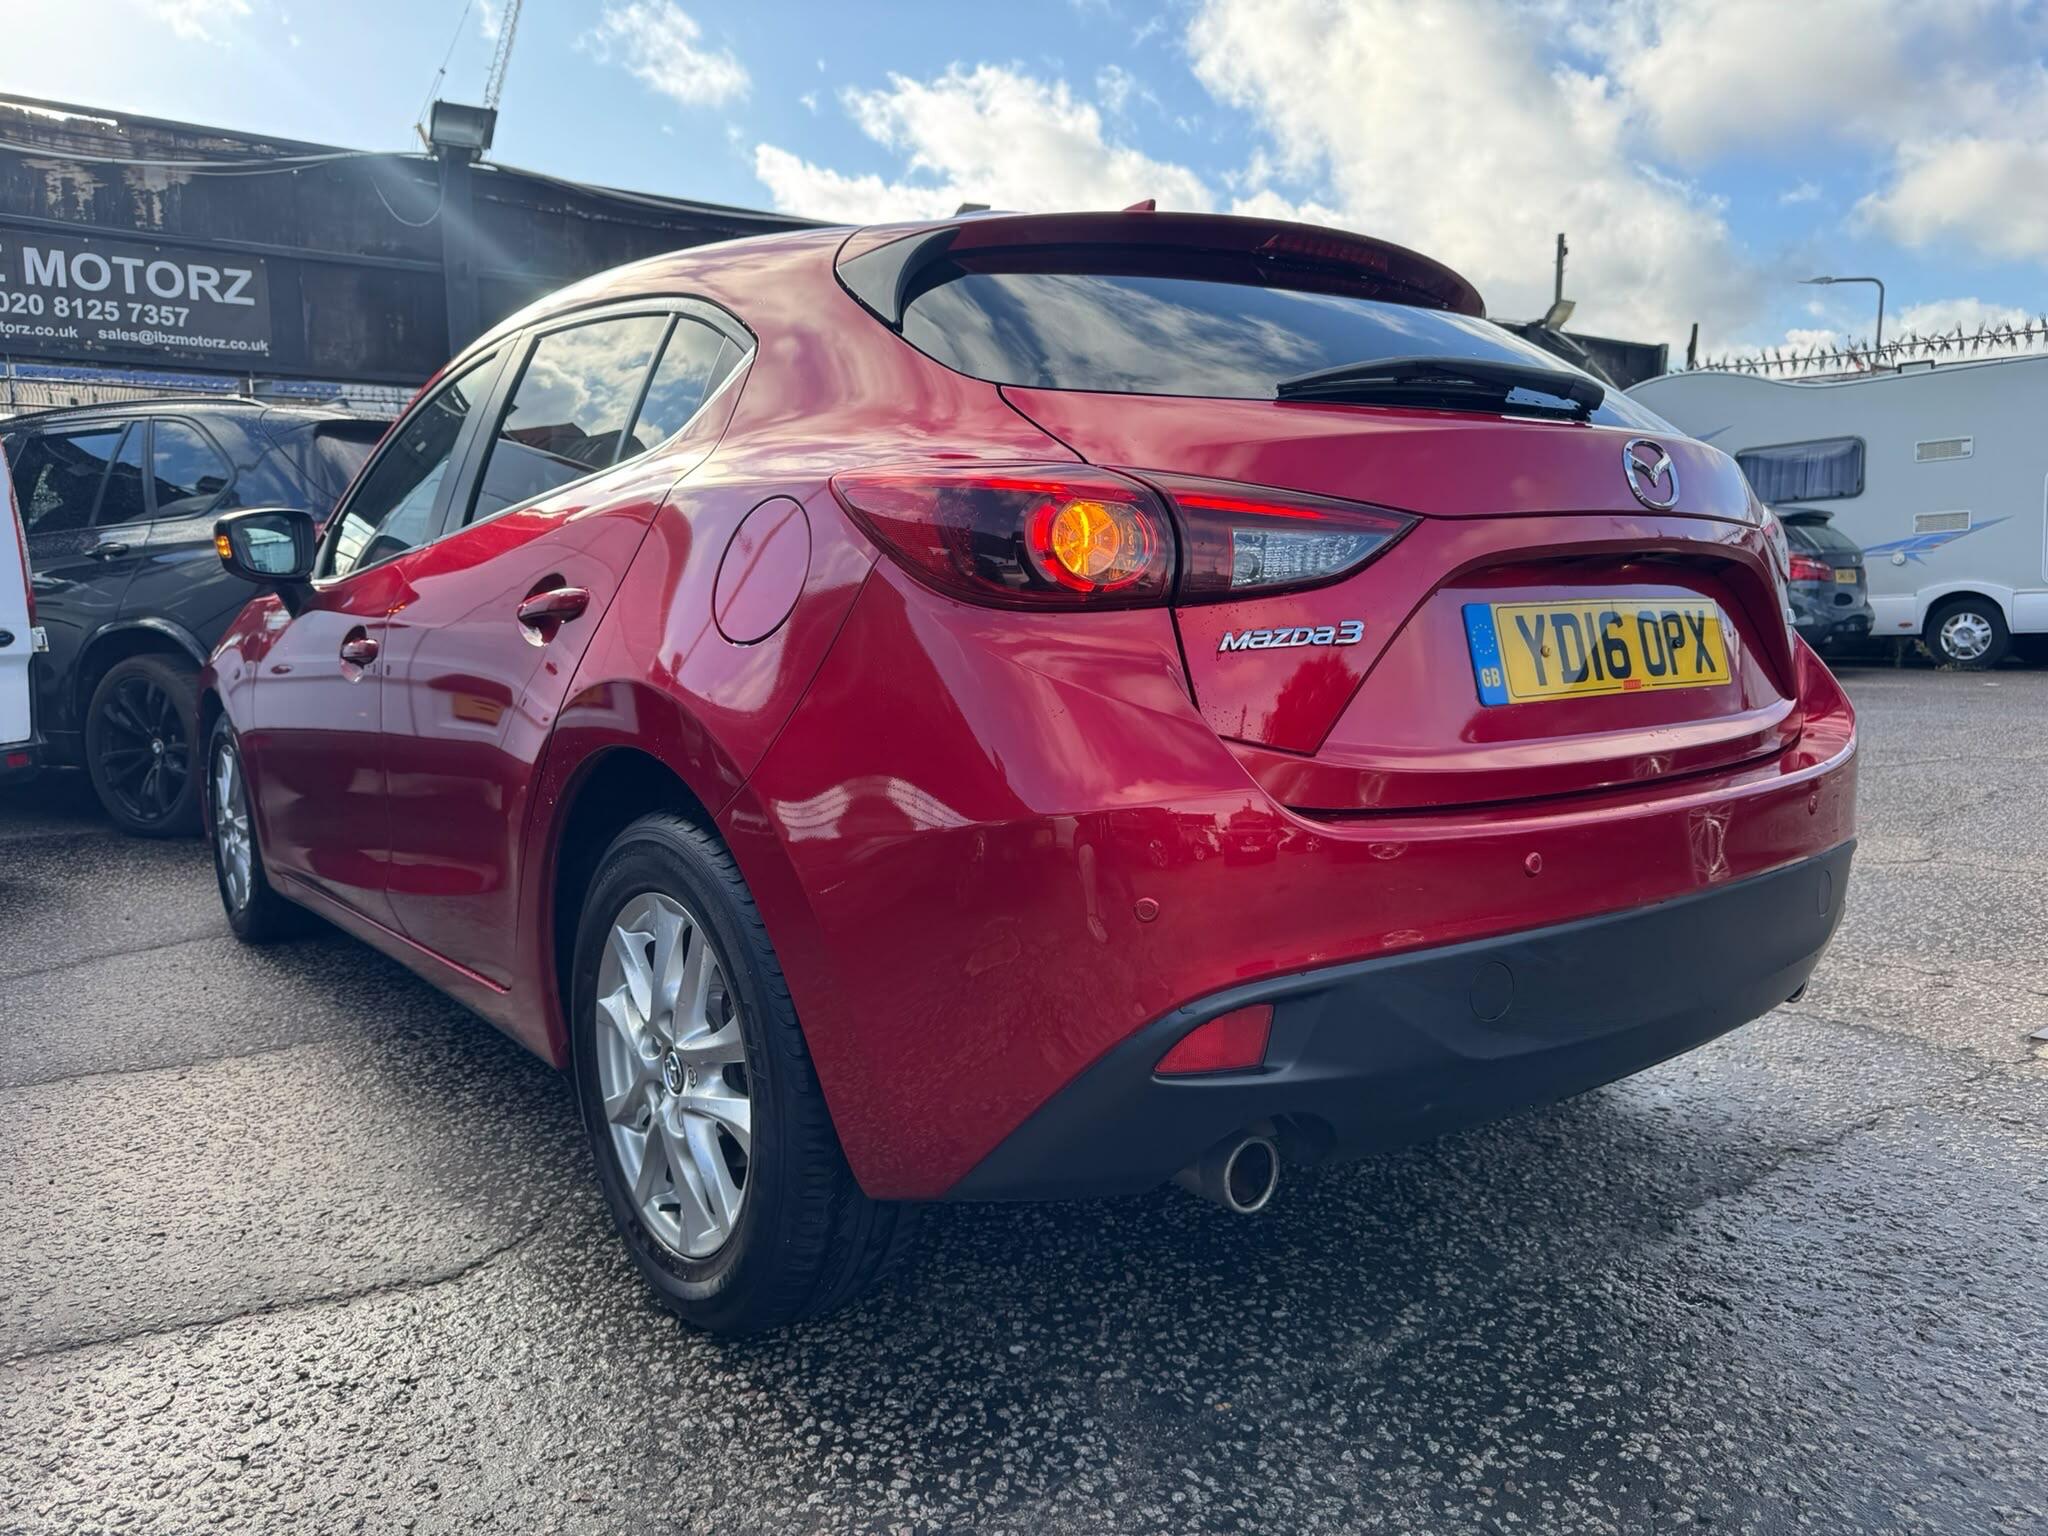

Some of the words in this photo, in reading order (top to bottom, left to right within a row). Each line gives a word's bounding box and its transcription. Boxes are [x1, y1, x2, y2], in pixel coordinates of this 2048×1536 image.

[23, 247, 255, 306] MOTORZ
[54, 296, 120, 321] 8125
[127, 303, 190, 327] 7357
[98, 328, 269, 351] sales@ibzmotorz.co.uk
[1515, 611, 1632, 686] YD16
[1637, 610, 1716, 677] OPX
[1481, 666, 1501, 688] GB
